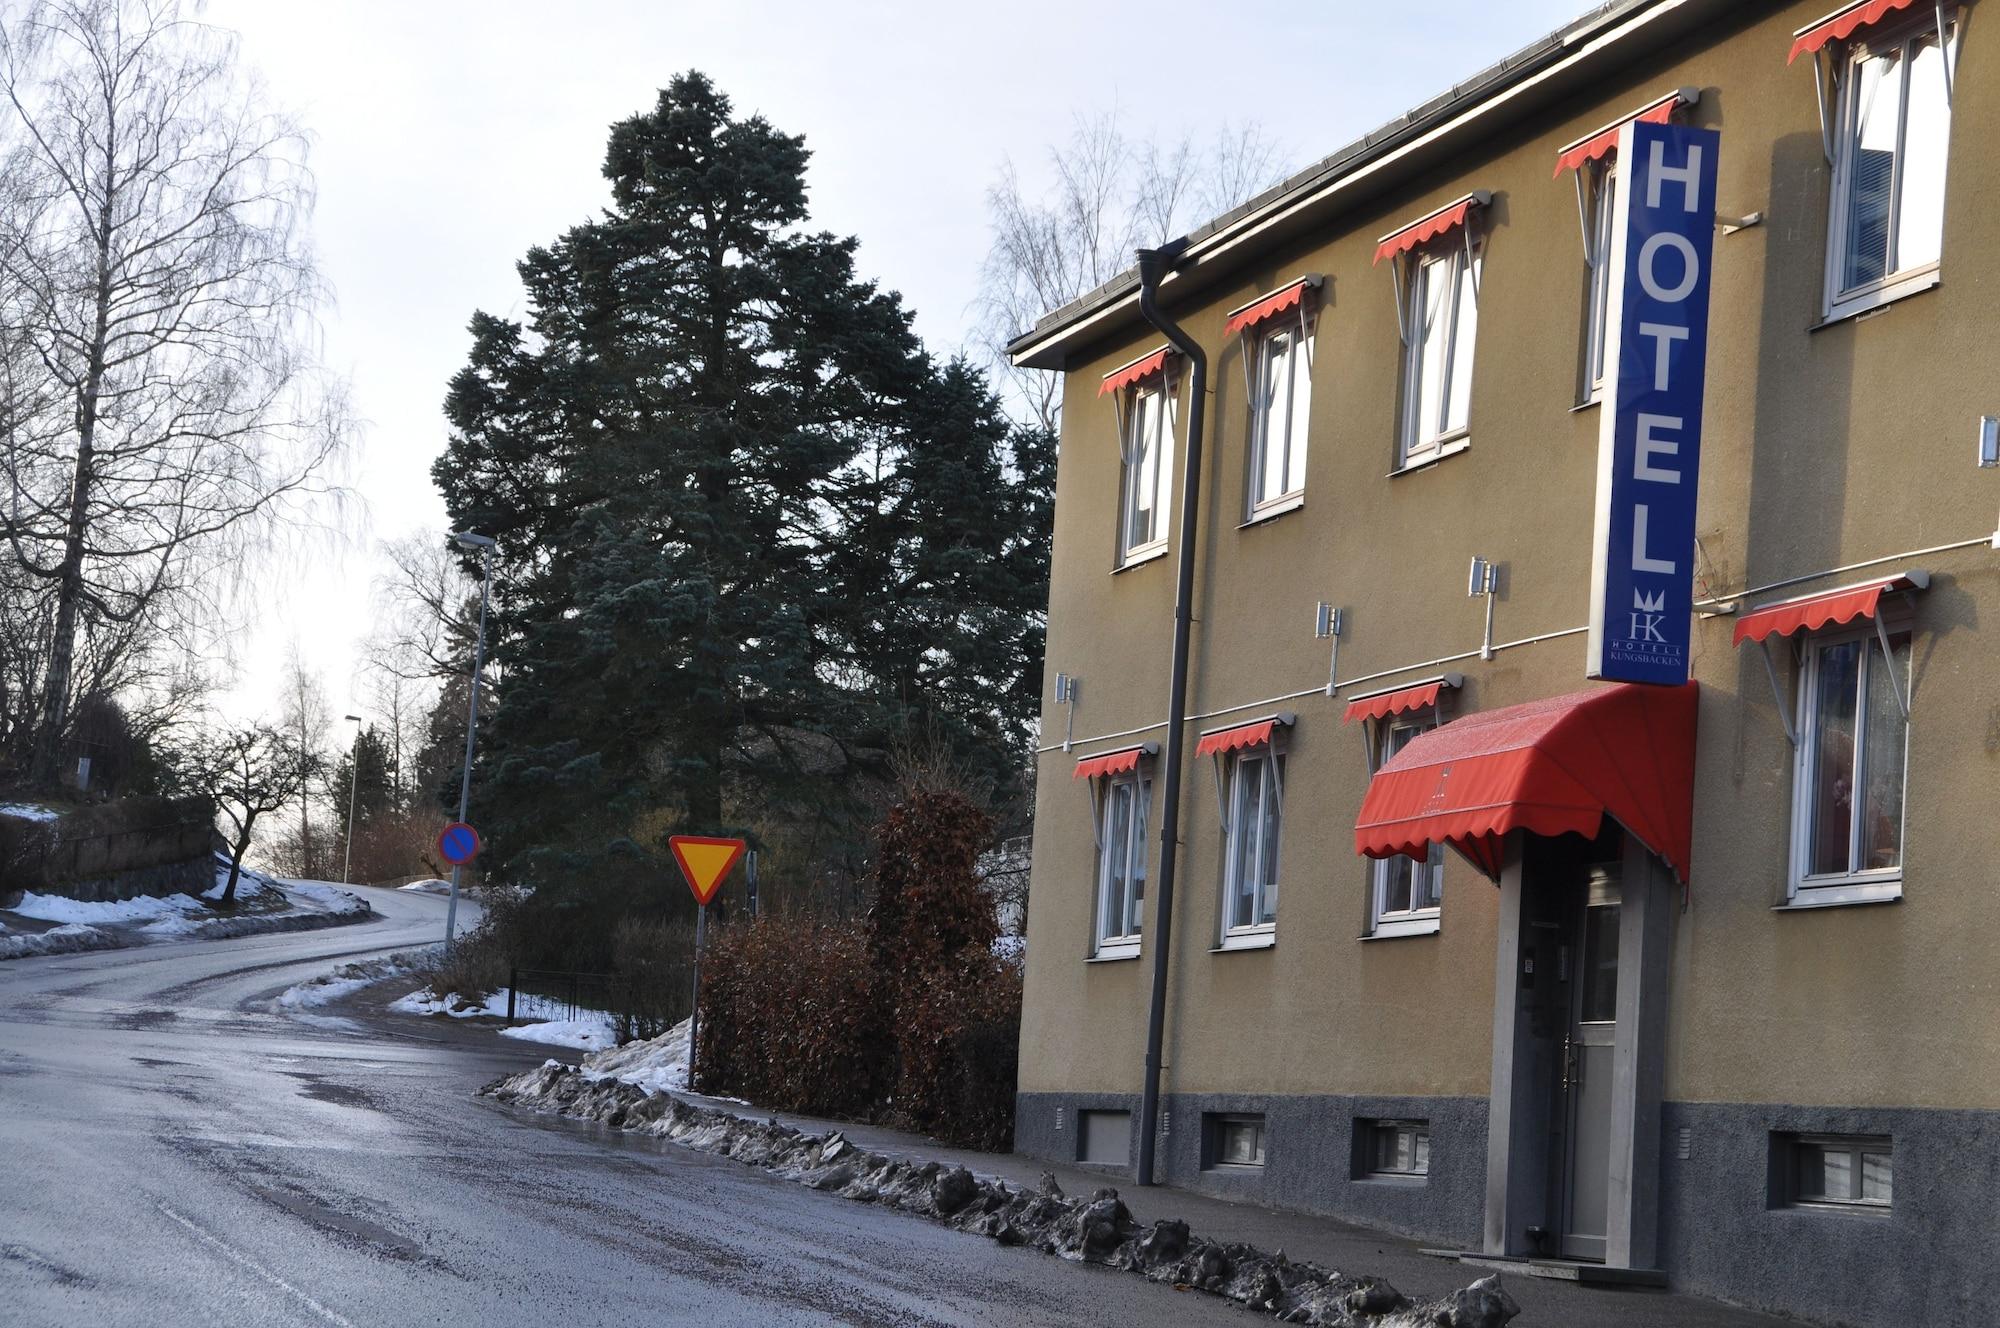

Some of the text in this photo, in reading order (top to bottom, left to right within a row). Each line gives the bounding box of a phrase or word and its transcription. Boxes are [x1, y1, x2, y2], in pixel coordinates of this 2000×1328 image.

[1631, 140, 1702, 575] HOTEL
[1628, 611, 1668, 643] HK
[1610, 651, 1681, 666] KUNGSBACKEN
[1612, 641, 1681, 655] HOTELL
